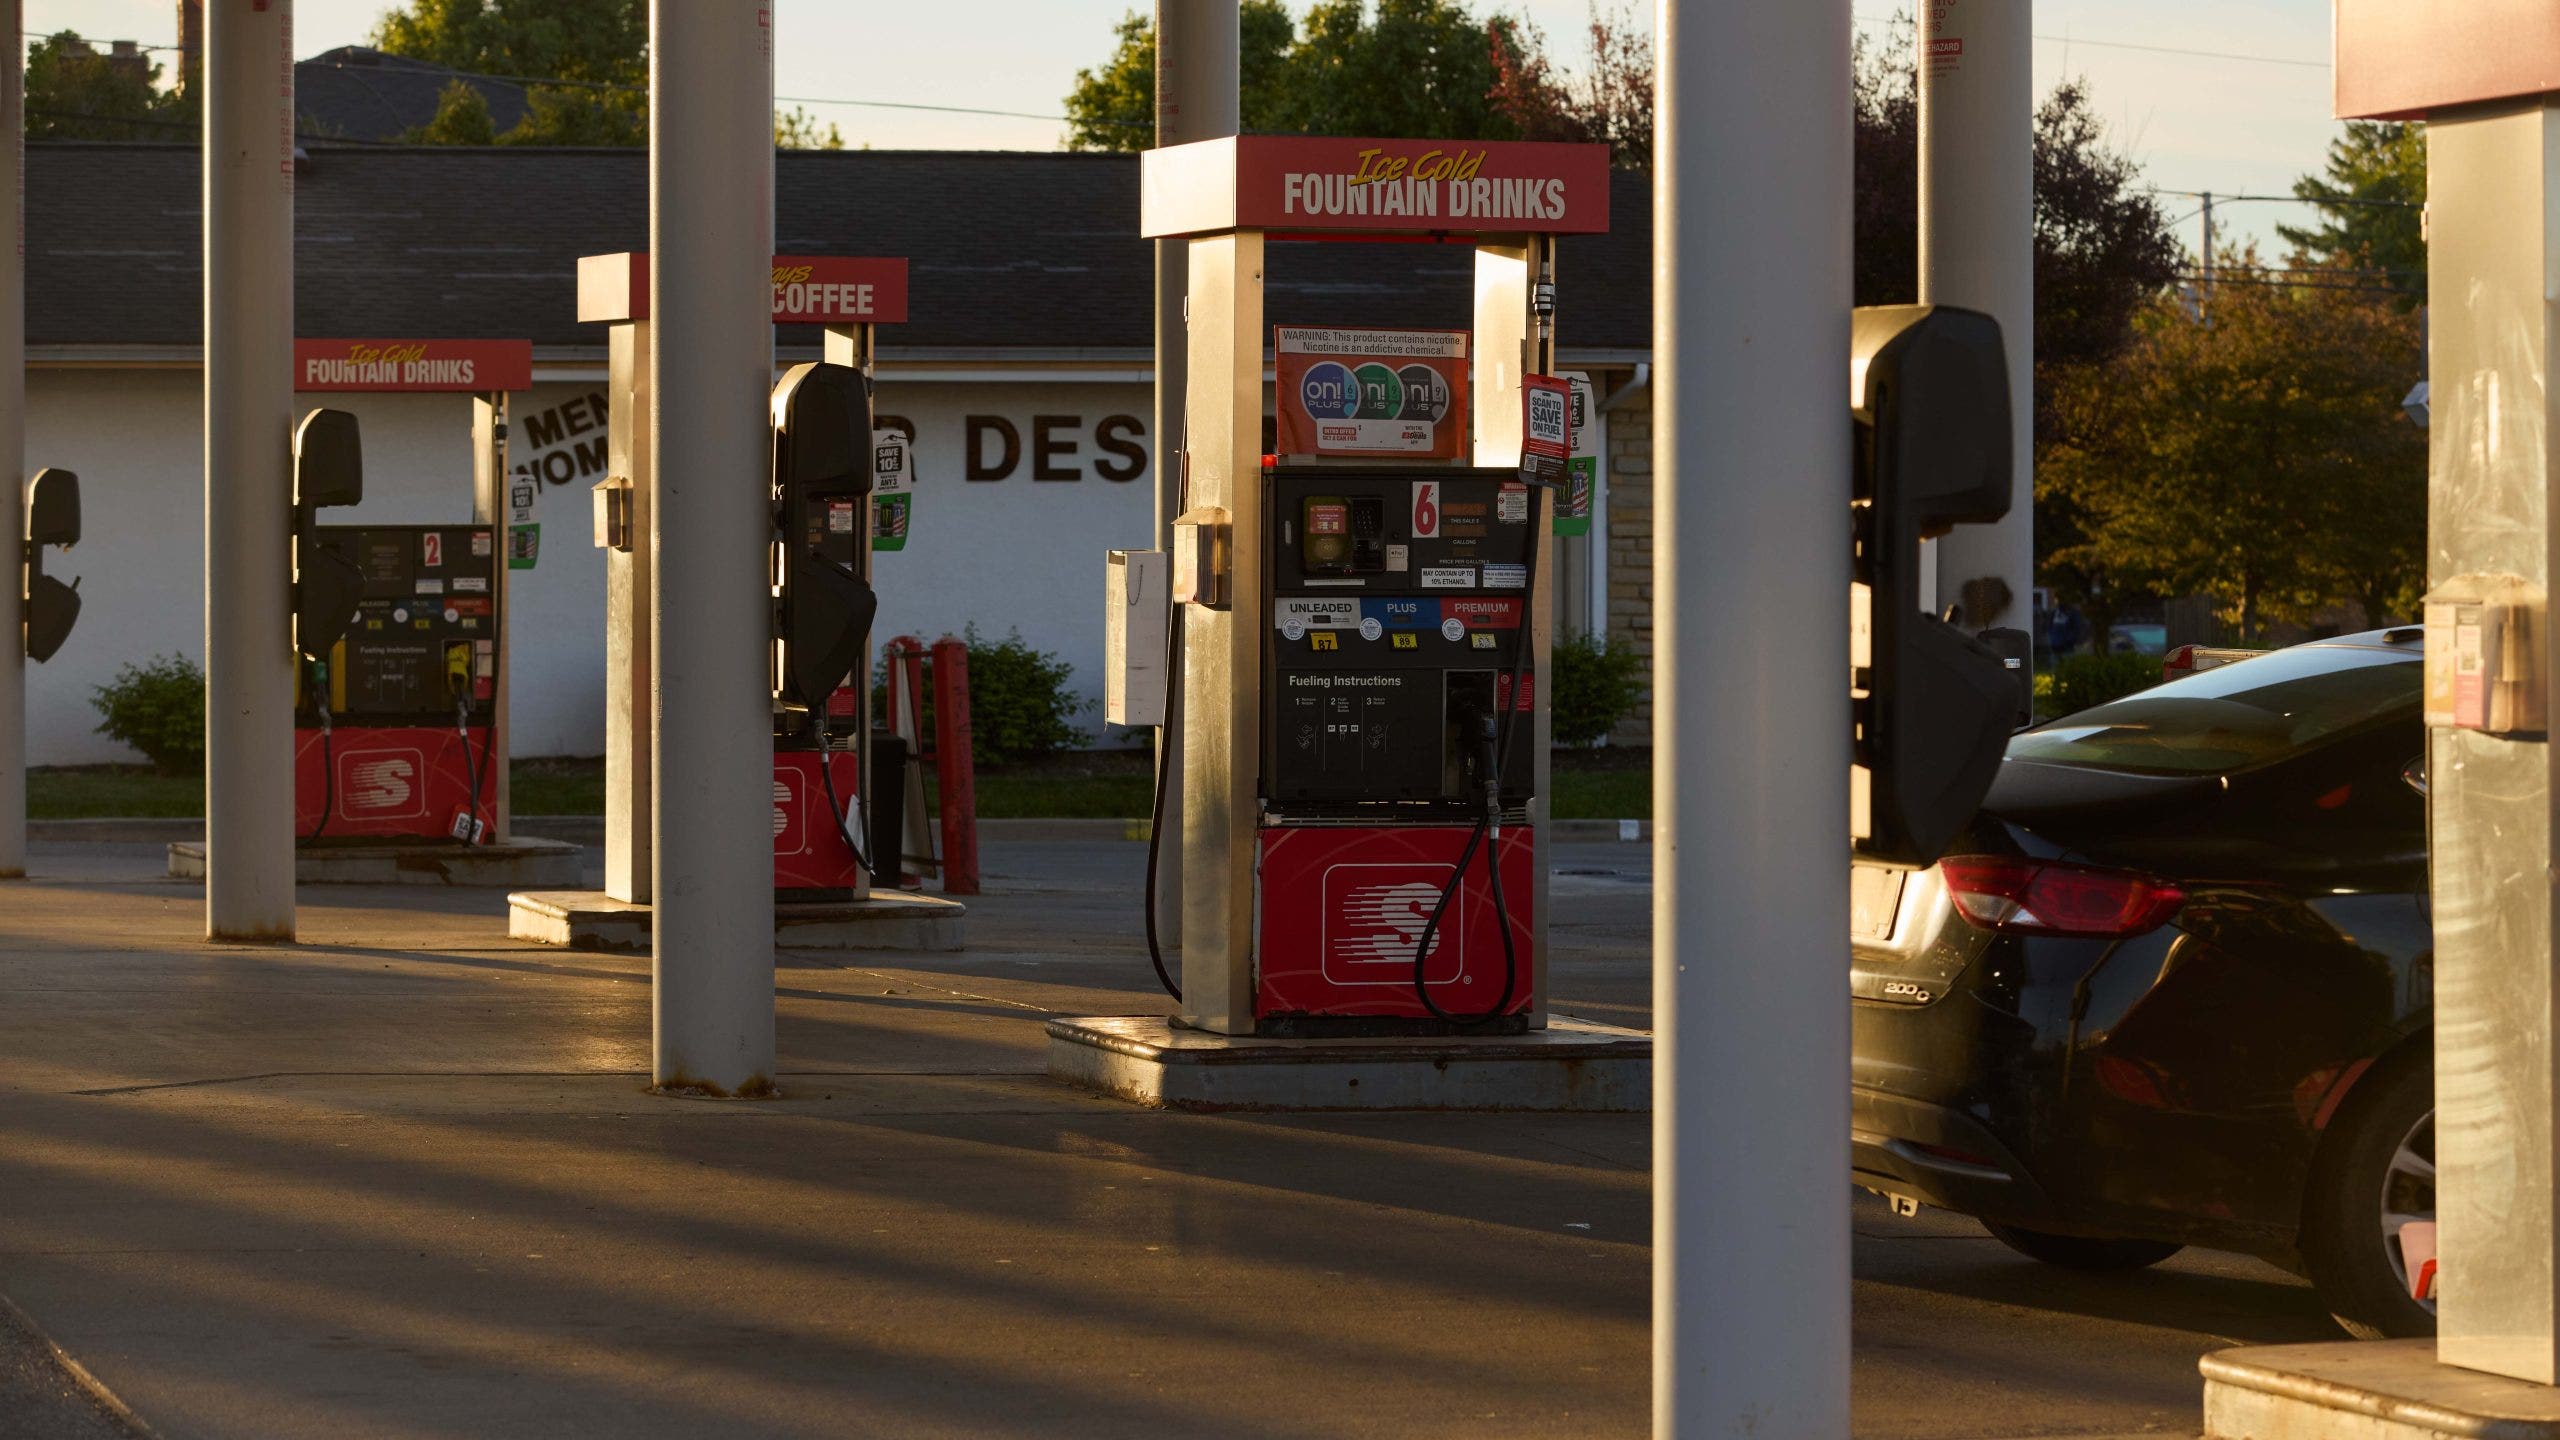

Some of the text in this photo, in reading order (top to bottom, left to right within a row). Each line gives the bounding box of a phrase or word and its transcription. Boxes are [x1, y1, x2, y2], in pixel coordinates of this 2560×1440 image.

[1348, 147, 1487, 186] Ice Cold
[1284, 173, 1566, 220] FOUNTAIN DRINKS
[772, 283, 874, 315] COFFEE
[1283, 331, 1463, 345] WARNING: This product contains nicotine.
[346, 343, 428, 367] Ice Cold
[1303, 342, 1446, 355] Nicotine is an addictive chemical.
[306, 359, 475, 384] FOUNTAIN DRINKS
[1307, 401, 1341, 409] PLUS
[1532, 397, 1551, 410] SCAN
[1552, 401, 1561, 410] TO
[1532, 407, 1561, 425] SAVE
[1532, 422, 1561, 436] ON FUEL
[965, 414, 1148, 483] DES
[1572, 436, 1578, 447] 3
[879, 448, 899, 458] SAVE
[1415, 484, 1437, 536] 6
[426, 535, 439, 564] 2
[1290, 603, 1509, 613] UNLEADED PLUS PREMIUM
[1318, 639, 1332, 651] 87
[1289, 675, 1401, 688] Fueling Instructions
[1330, 697, 1336, 706] 2
[1366, 697, 1372, 706] 3
